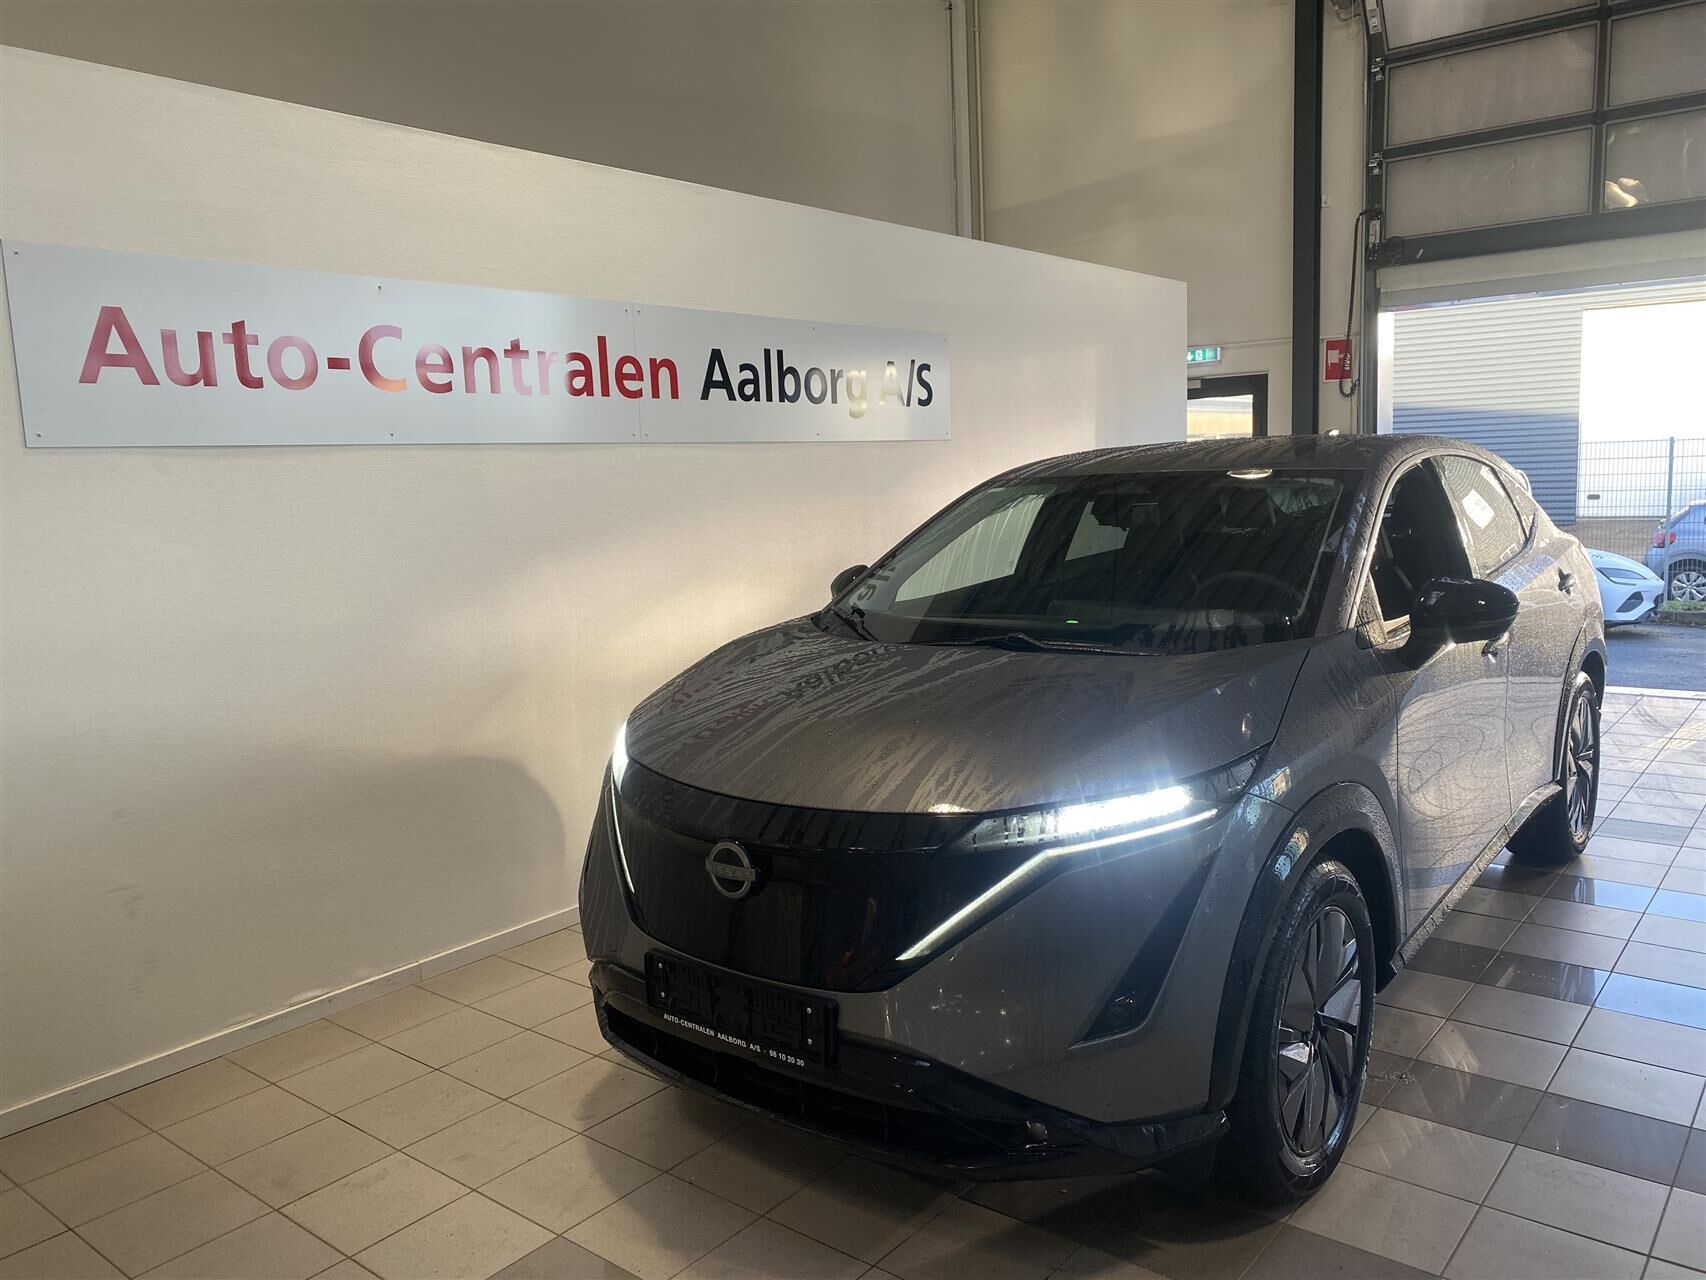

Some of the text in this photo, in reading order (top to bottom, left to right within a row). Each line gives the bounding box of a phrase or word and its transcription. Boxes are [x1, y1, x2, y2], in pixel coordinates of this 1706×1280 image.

[79, 305, 934, 418] Auto-Centralen Aalborg A/S
[663, 1013, 715, 1037] AUTO-CENTRALEN
[717, 1032, 747, 1048] AALBORG
[749, 1043, 761, 1053] A/S
[778, 1052, 786, 1061] 10
[787, 1055, 796, 1064] 20
